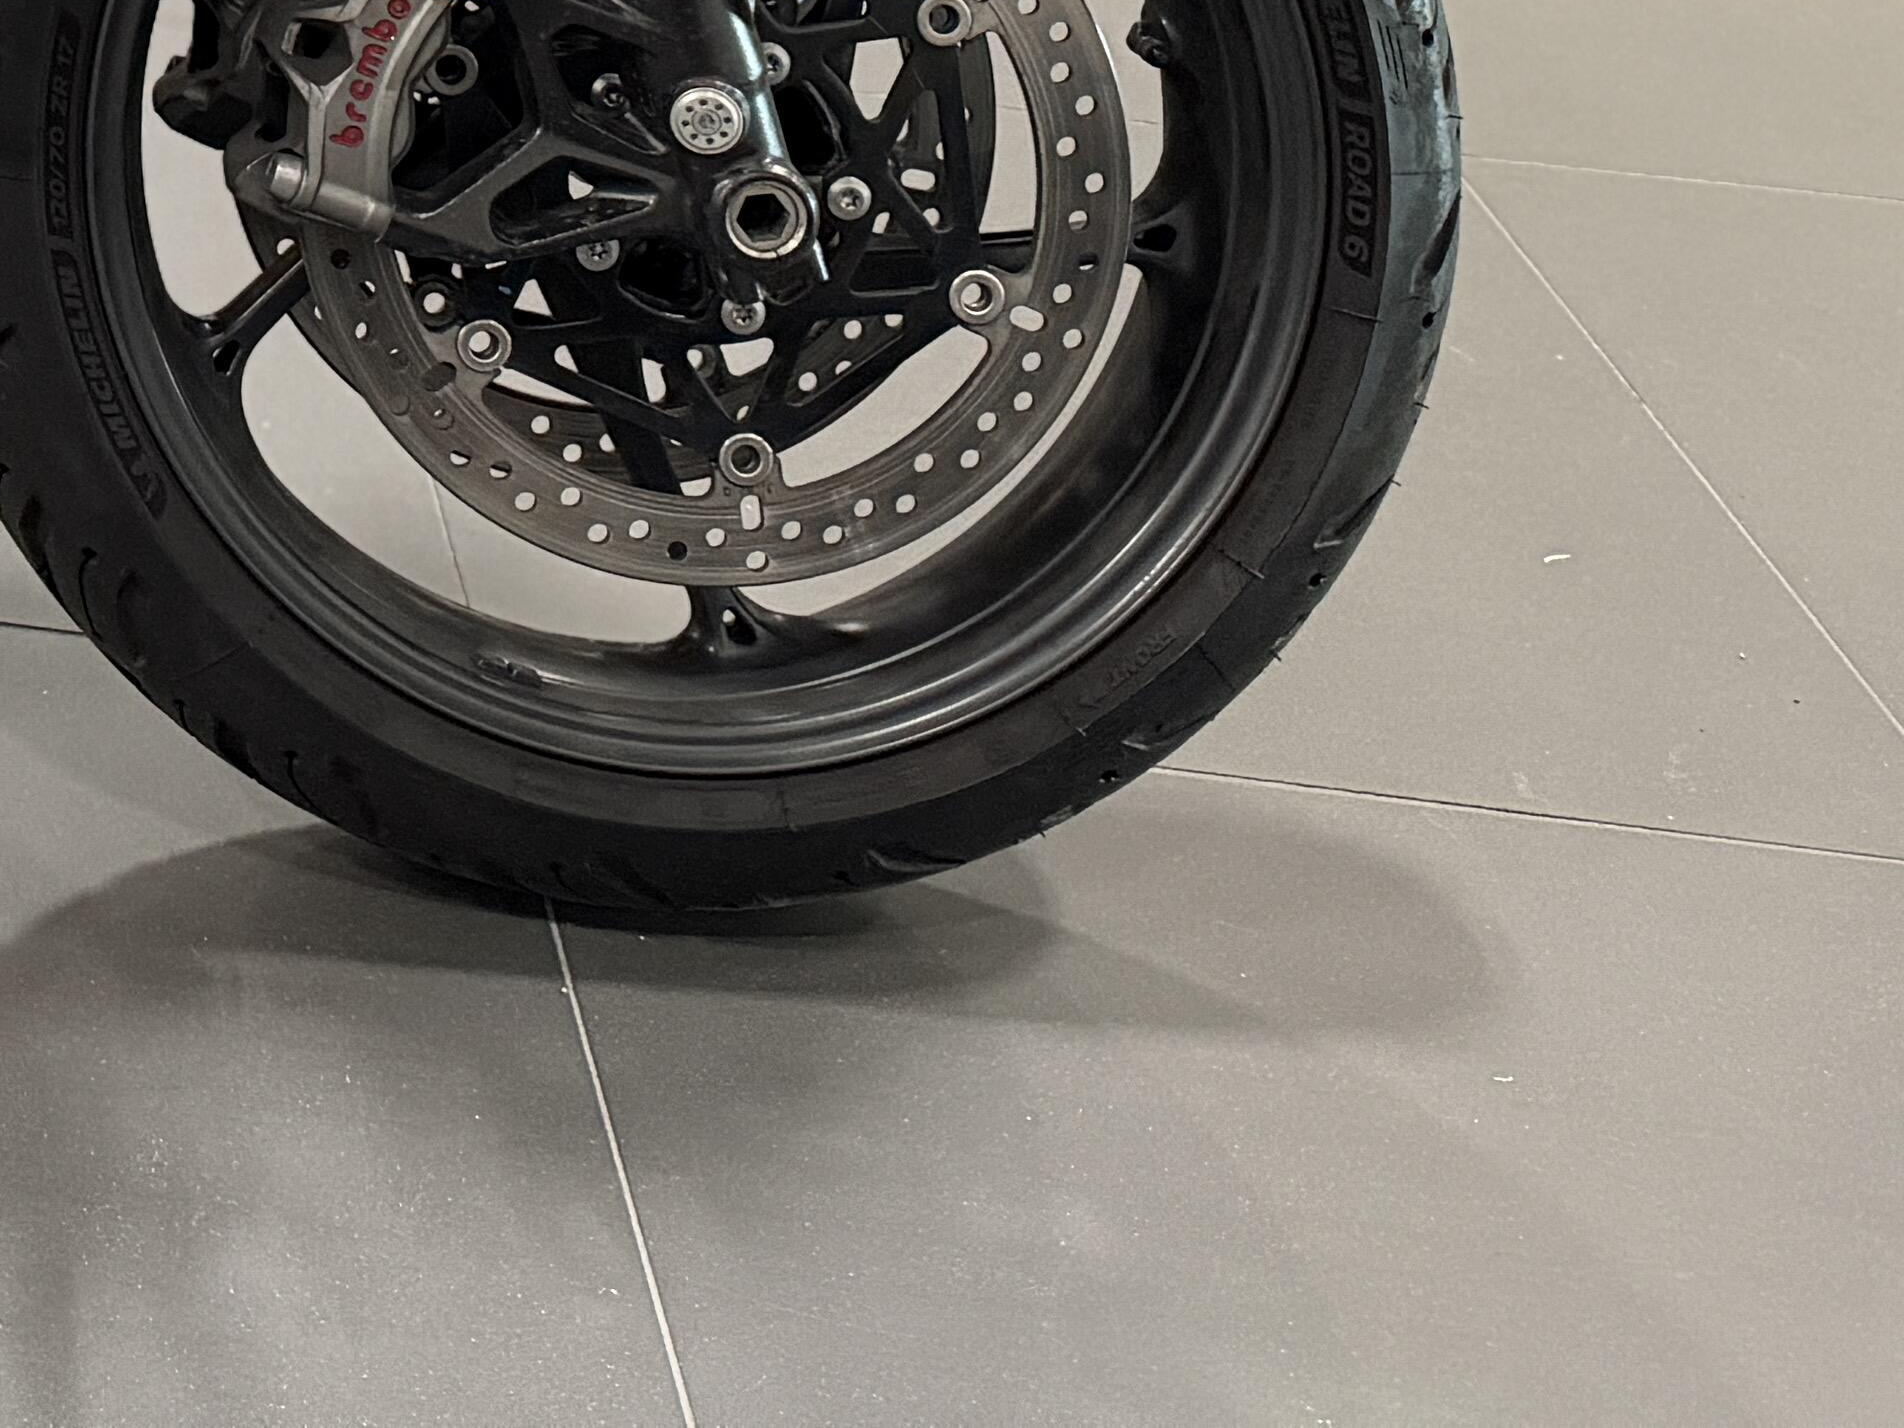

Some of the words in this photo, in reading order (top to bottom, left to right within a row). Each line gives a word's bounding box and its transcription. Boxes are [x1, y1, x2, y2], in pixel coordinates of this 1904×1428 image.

[56, 35, 75, 72] 17
[49, 75, 69, 120] ZR
[48, 124, 68, 227] 120/70
[1343, 120, 1373, 231] ROAD
[1341, 234, 1370, 262] 6
[54, 264, 140, 451] MICHELIN
